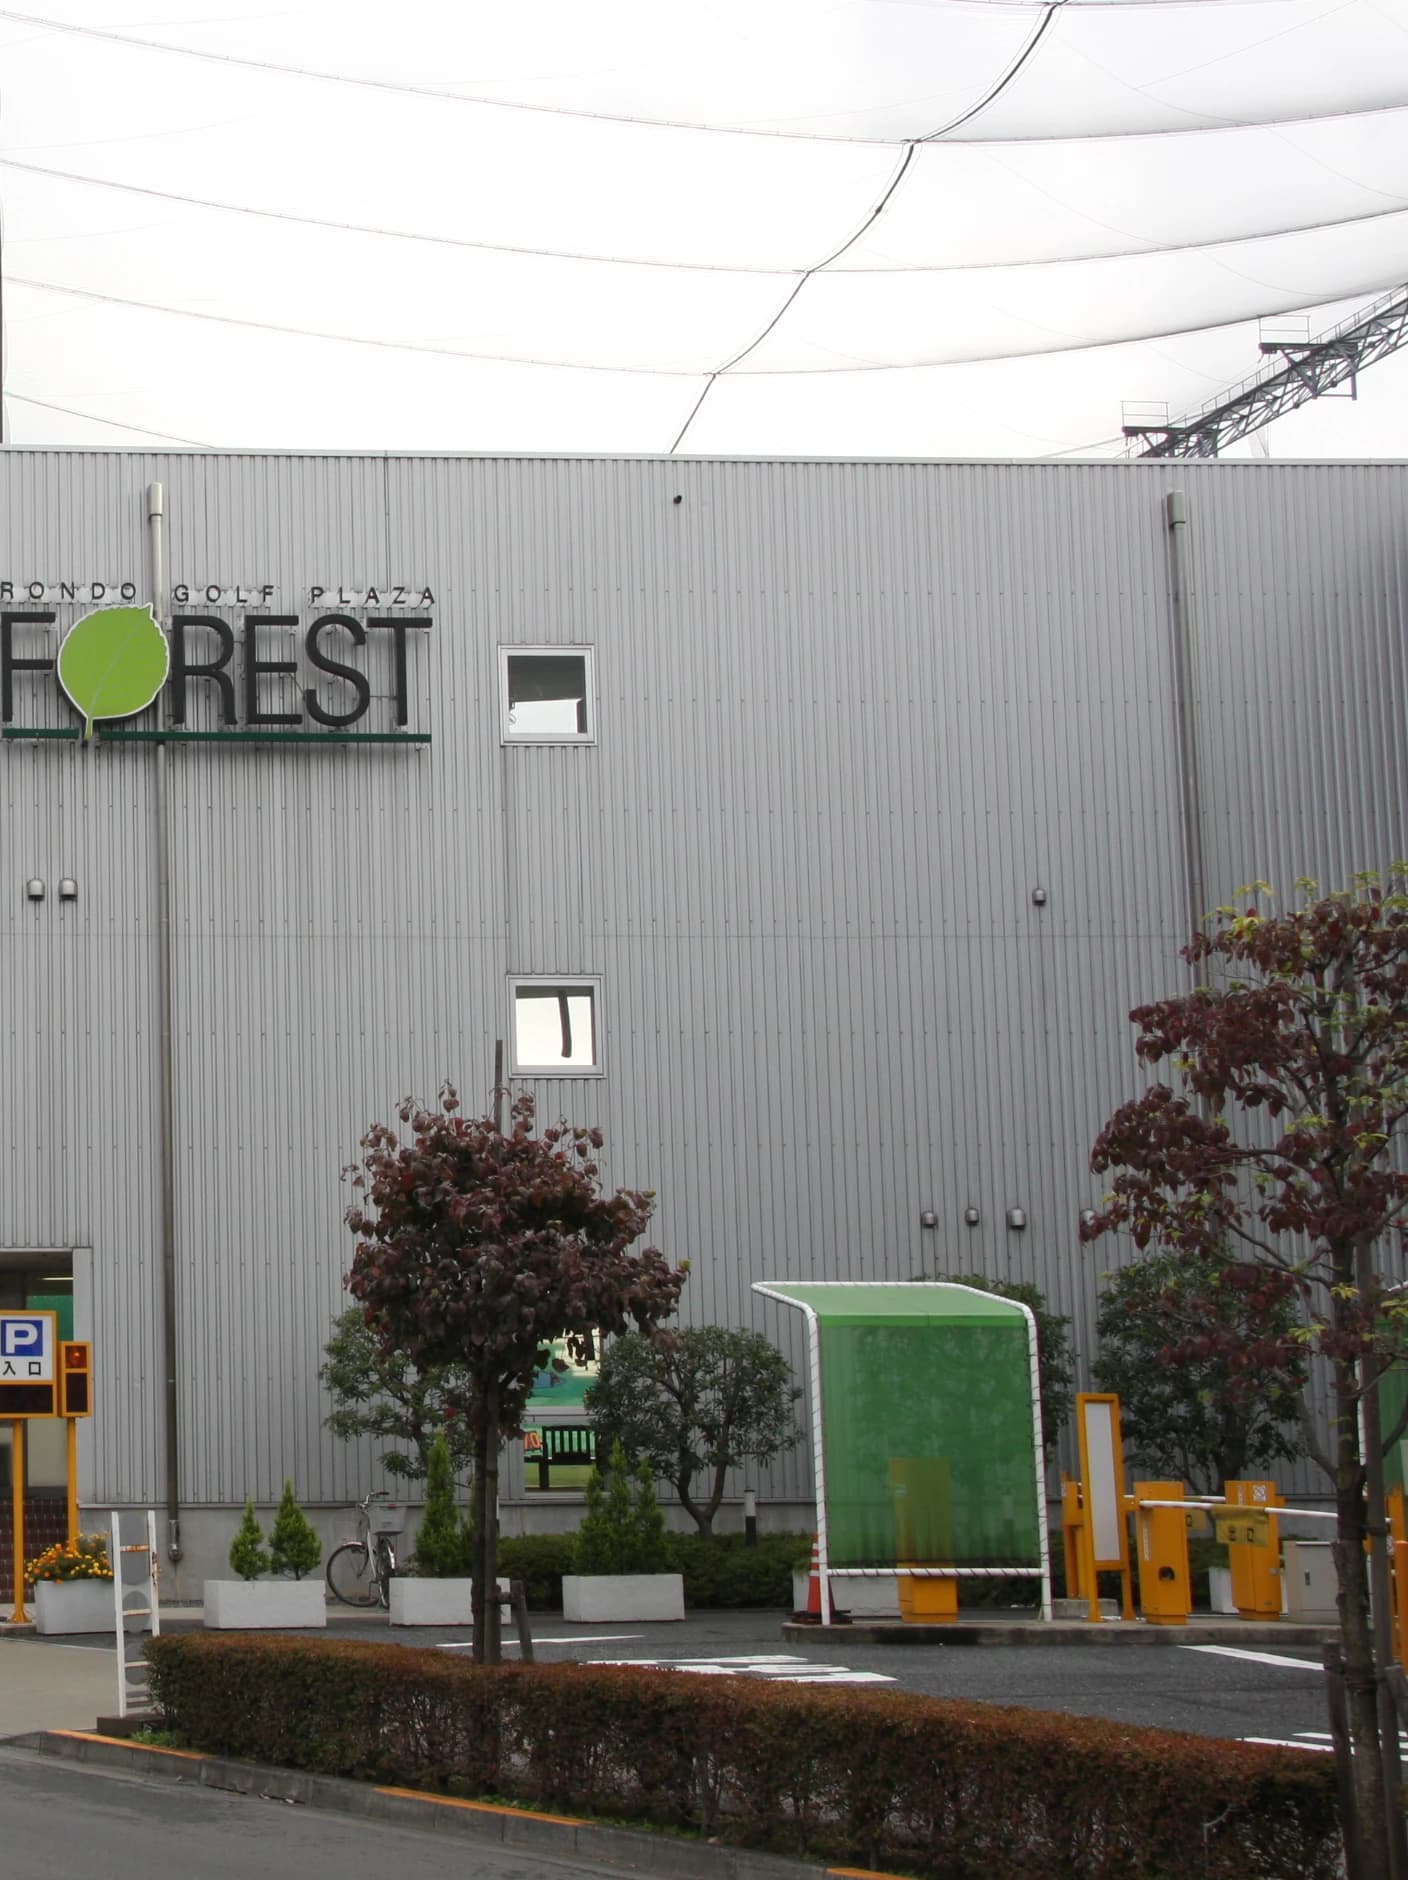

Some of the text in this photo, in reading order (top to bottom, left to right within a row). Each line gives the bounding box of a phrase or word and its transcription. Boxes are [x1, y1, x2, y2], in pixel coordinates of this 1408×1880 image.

[0, 582, 435, 604] RONDO GOLF PLAZA
[1, 603, 433, 728] FOREST
[5, 1323, 39, 1354] P
[2, 1361, 42, 1376] 入口
